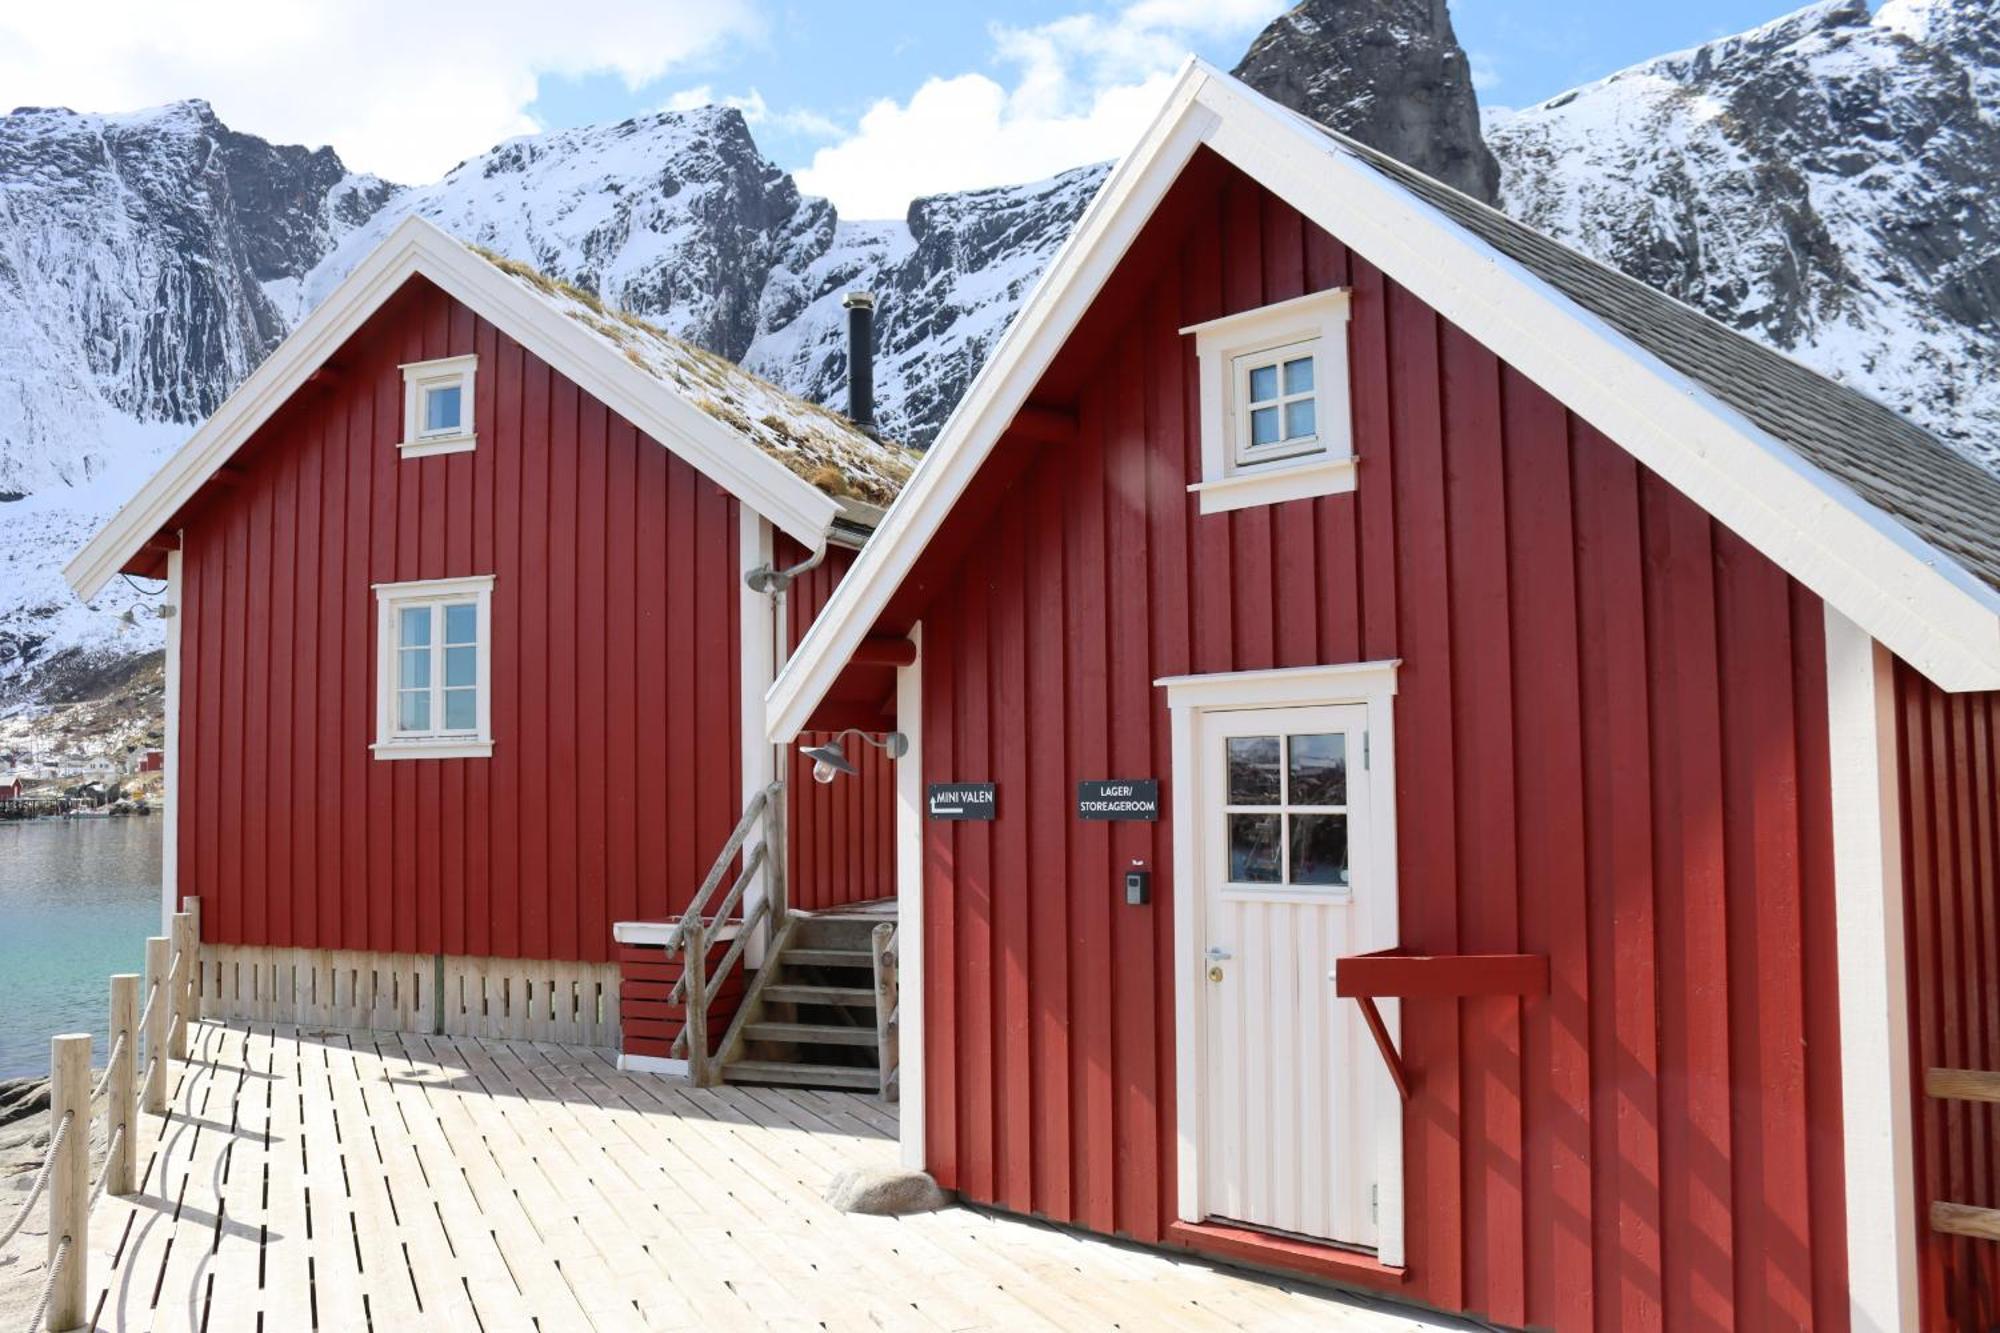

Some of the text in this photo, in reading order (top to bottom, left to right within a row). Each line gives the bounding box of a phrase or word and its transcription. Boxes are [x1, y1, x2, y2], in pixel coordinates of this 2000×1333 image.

[936, 791, 993, 803] MINI VALEN
[1101, 786, 1133, 797] LAGER/
[1080, 801, 1155, 811] STOREAGEROOM
